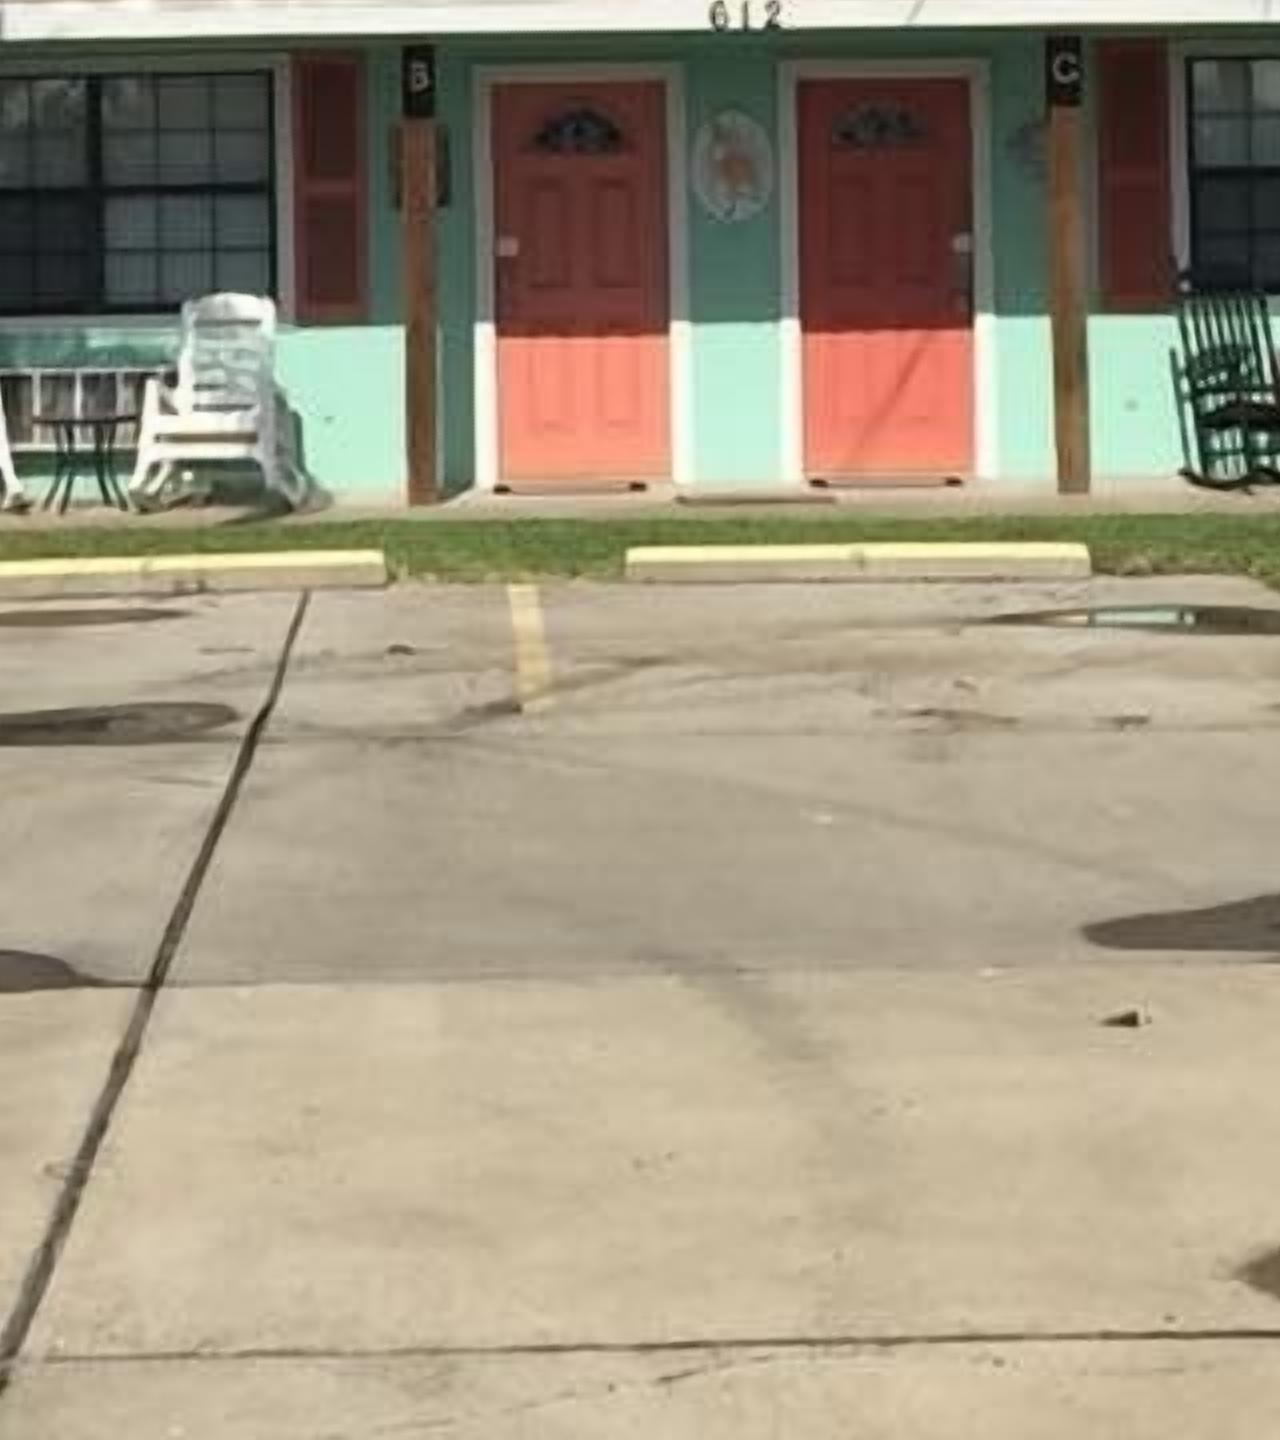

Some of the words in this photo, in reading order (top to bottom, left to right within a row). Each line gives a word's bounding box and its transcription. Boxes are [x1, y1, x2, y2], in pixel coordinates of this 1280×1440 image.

[709, 0, 782, 33] 612
[410, 61, 429, 92] B
[1052, 52, 1080, 83] C
